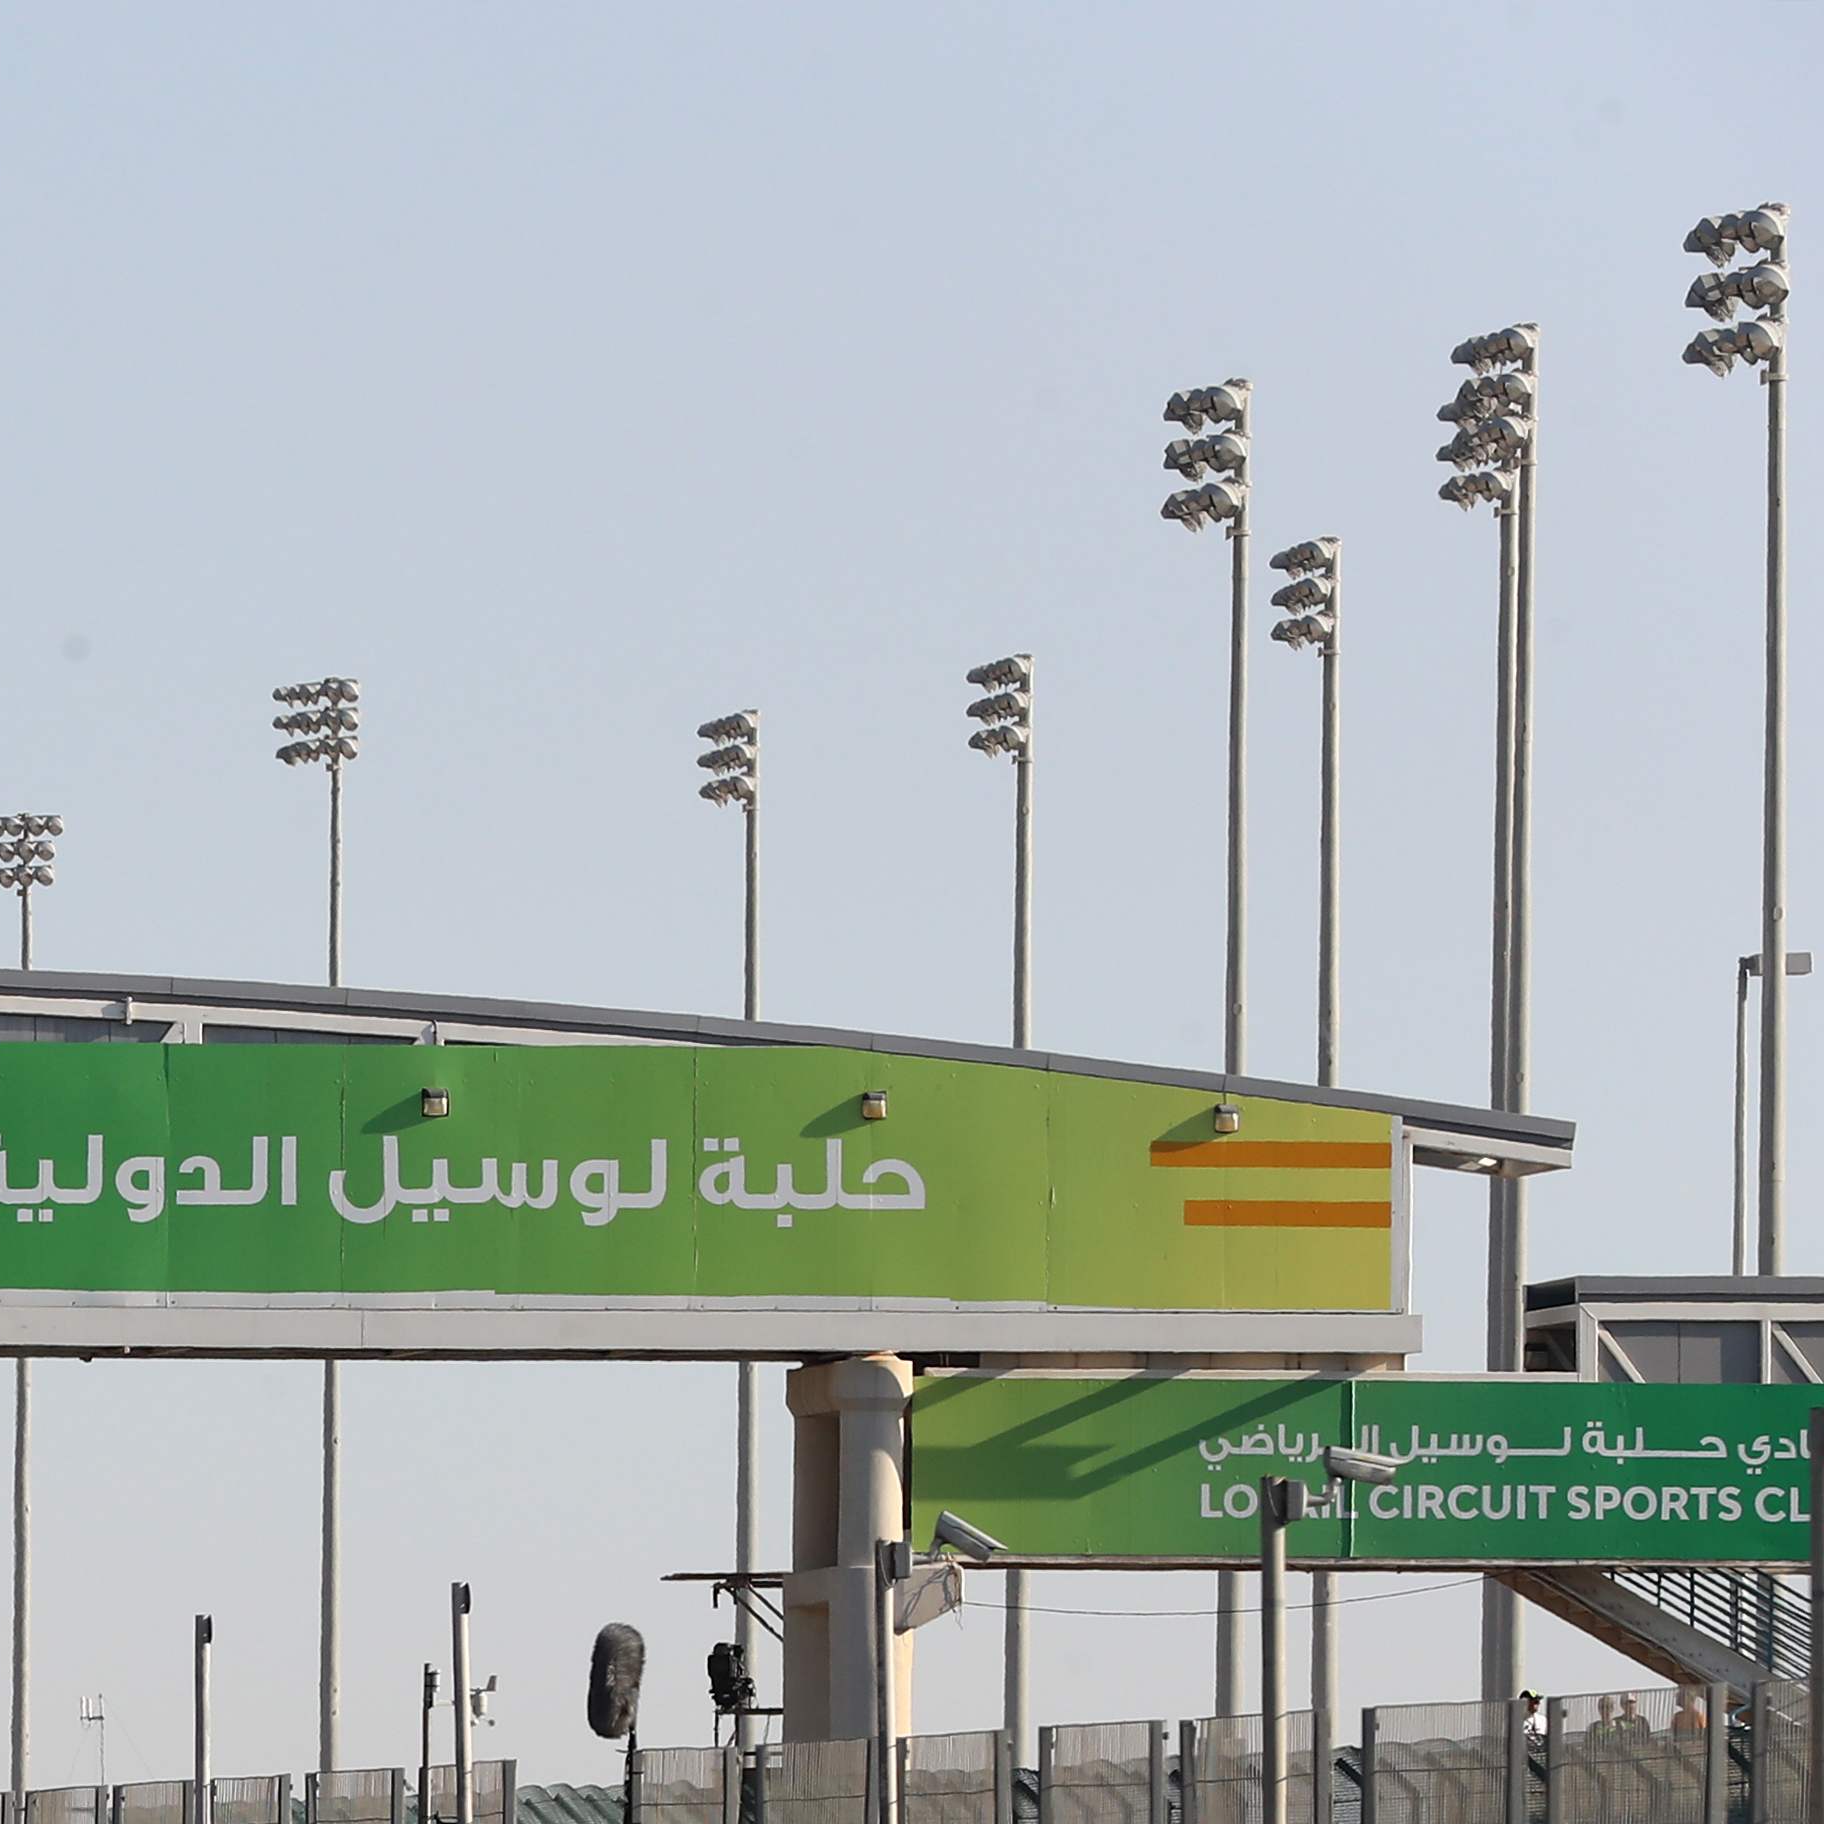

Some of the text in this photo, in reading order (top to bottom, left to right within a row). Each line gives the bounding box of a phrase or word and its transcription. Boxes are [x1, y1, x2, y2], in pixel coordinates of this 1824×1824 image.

[328, 1135, 667, 1227] لوسيل
[698, 1136, 926, 1228] حلبة
[1582, 1421, 1728, 1465] حلبة
[1737, 1429, 1811, 1475] ادي
[1369, 1484, 1557, 1521] CIRCUIT
[1567, 1485, 1743, 1521] SPORTS
[1754, 1487, 1811, 1523] CL
